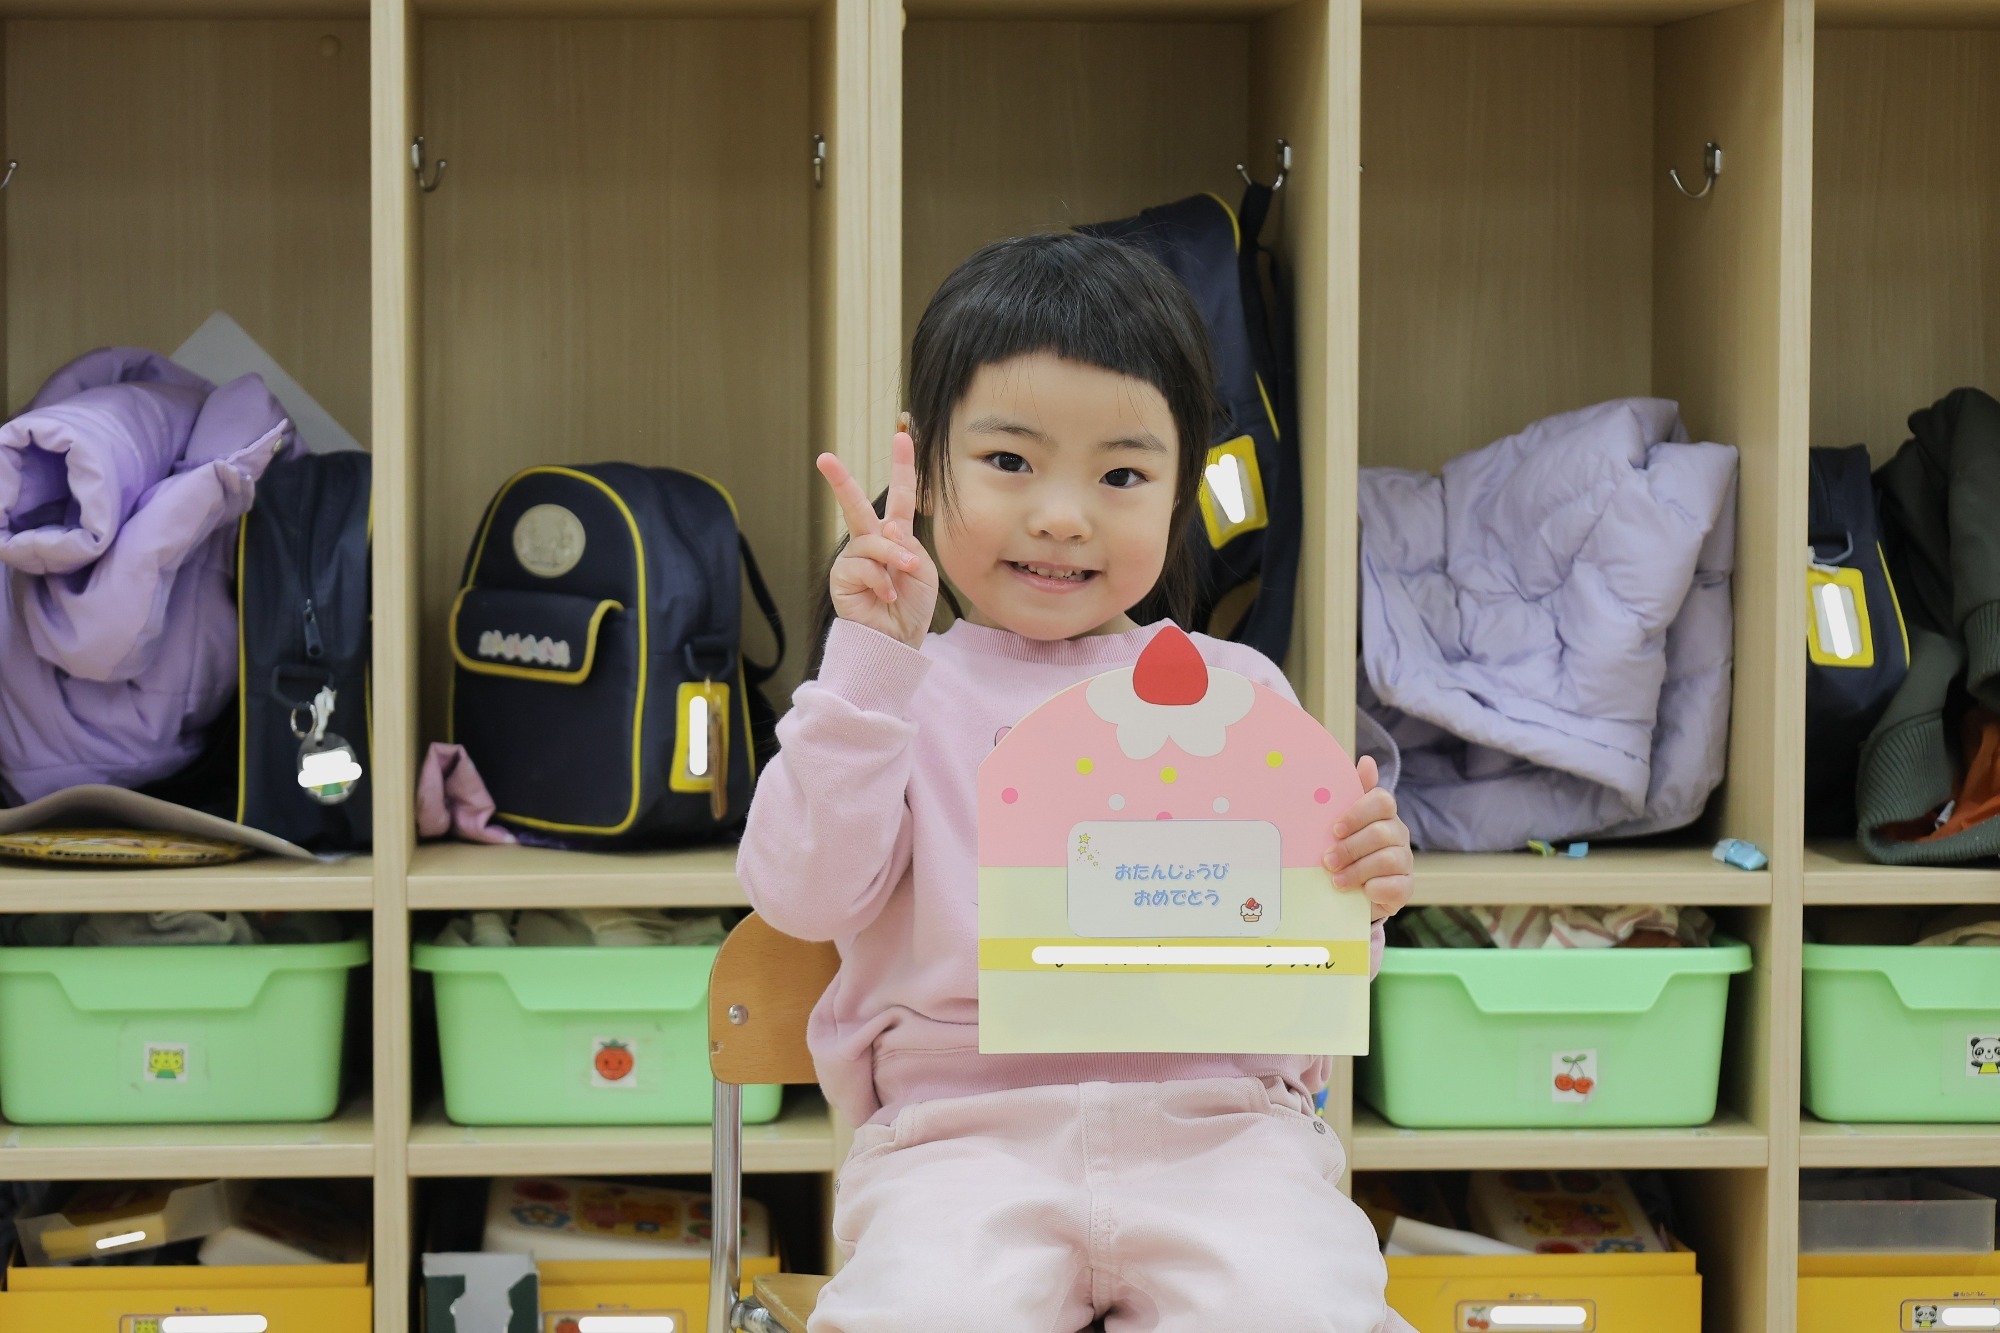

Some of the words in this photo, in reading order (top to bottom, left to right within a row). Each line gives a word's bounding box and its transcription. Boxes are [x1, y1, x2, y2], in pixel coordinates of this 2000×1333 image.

[1114, 863, 1229, 880] おたんじょうび
[1133, 889, 1220, 906] おめでとう
